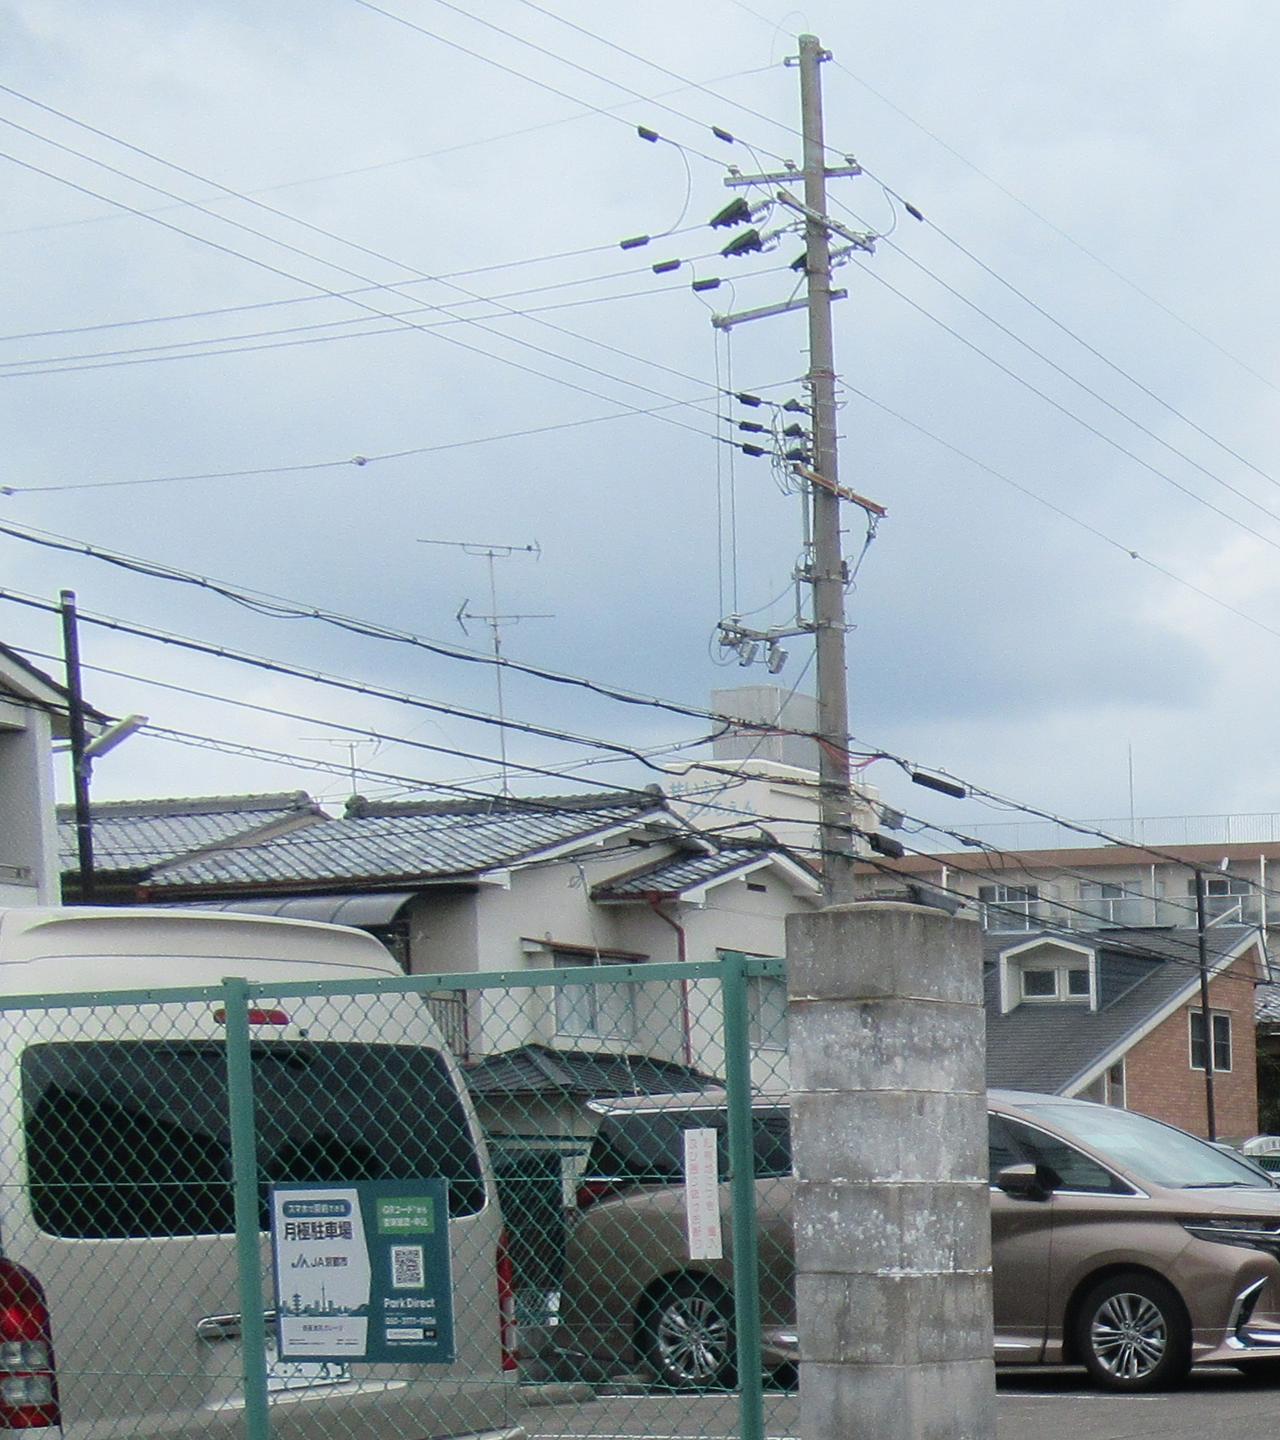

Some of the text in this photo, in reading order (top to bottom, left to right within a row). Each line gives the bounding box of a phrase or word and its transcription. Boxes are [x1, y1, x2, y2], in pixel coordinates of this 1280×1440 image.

[284, 1221, 353, 1241] 月極駐車場
